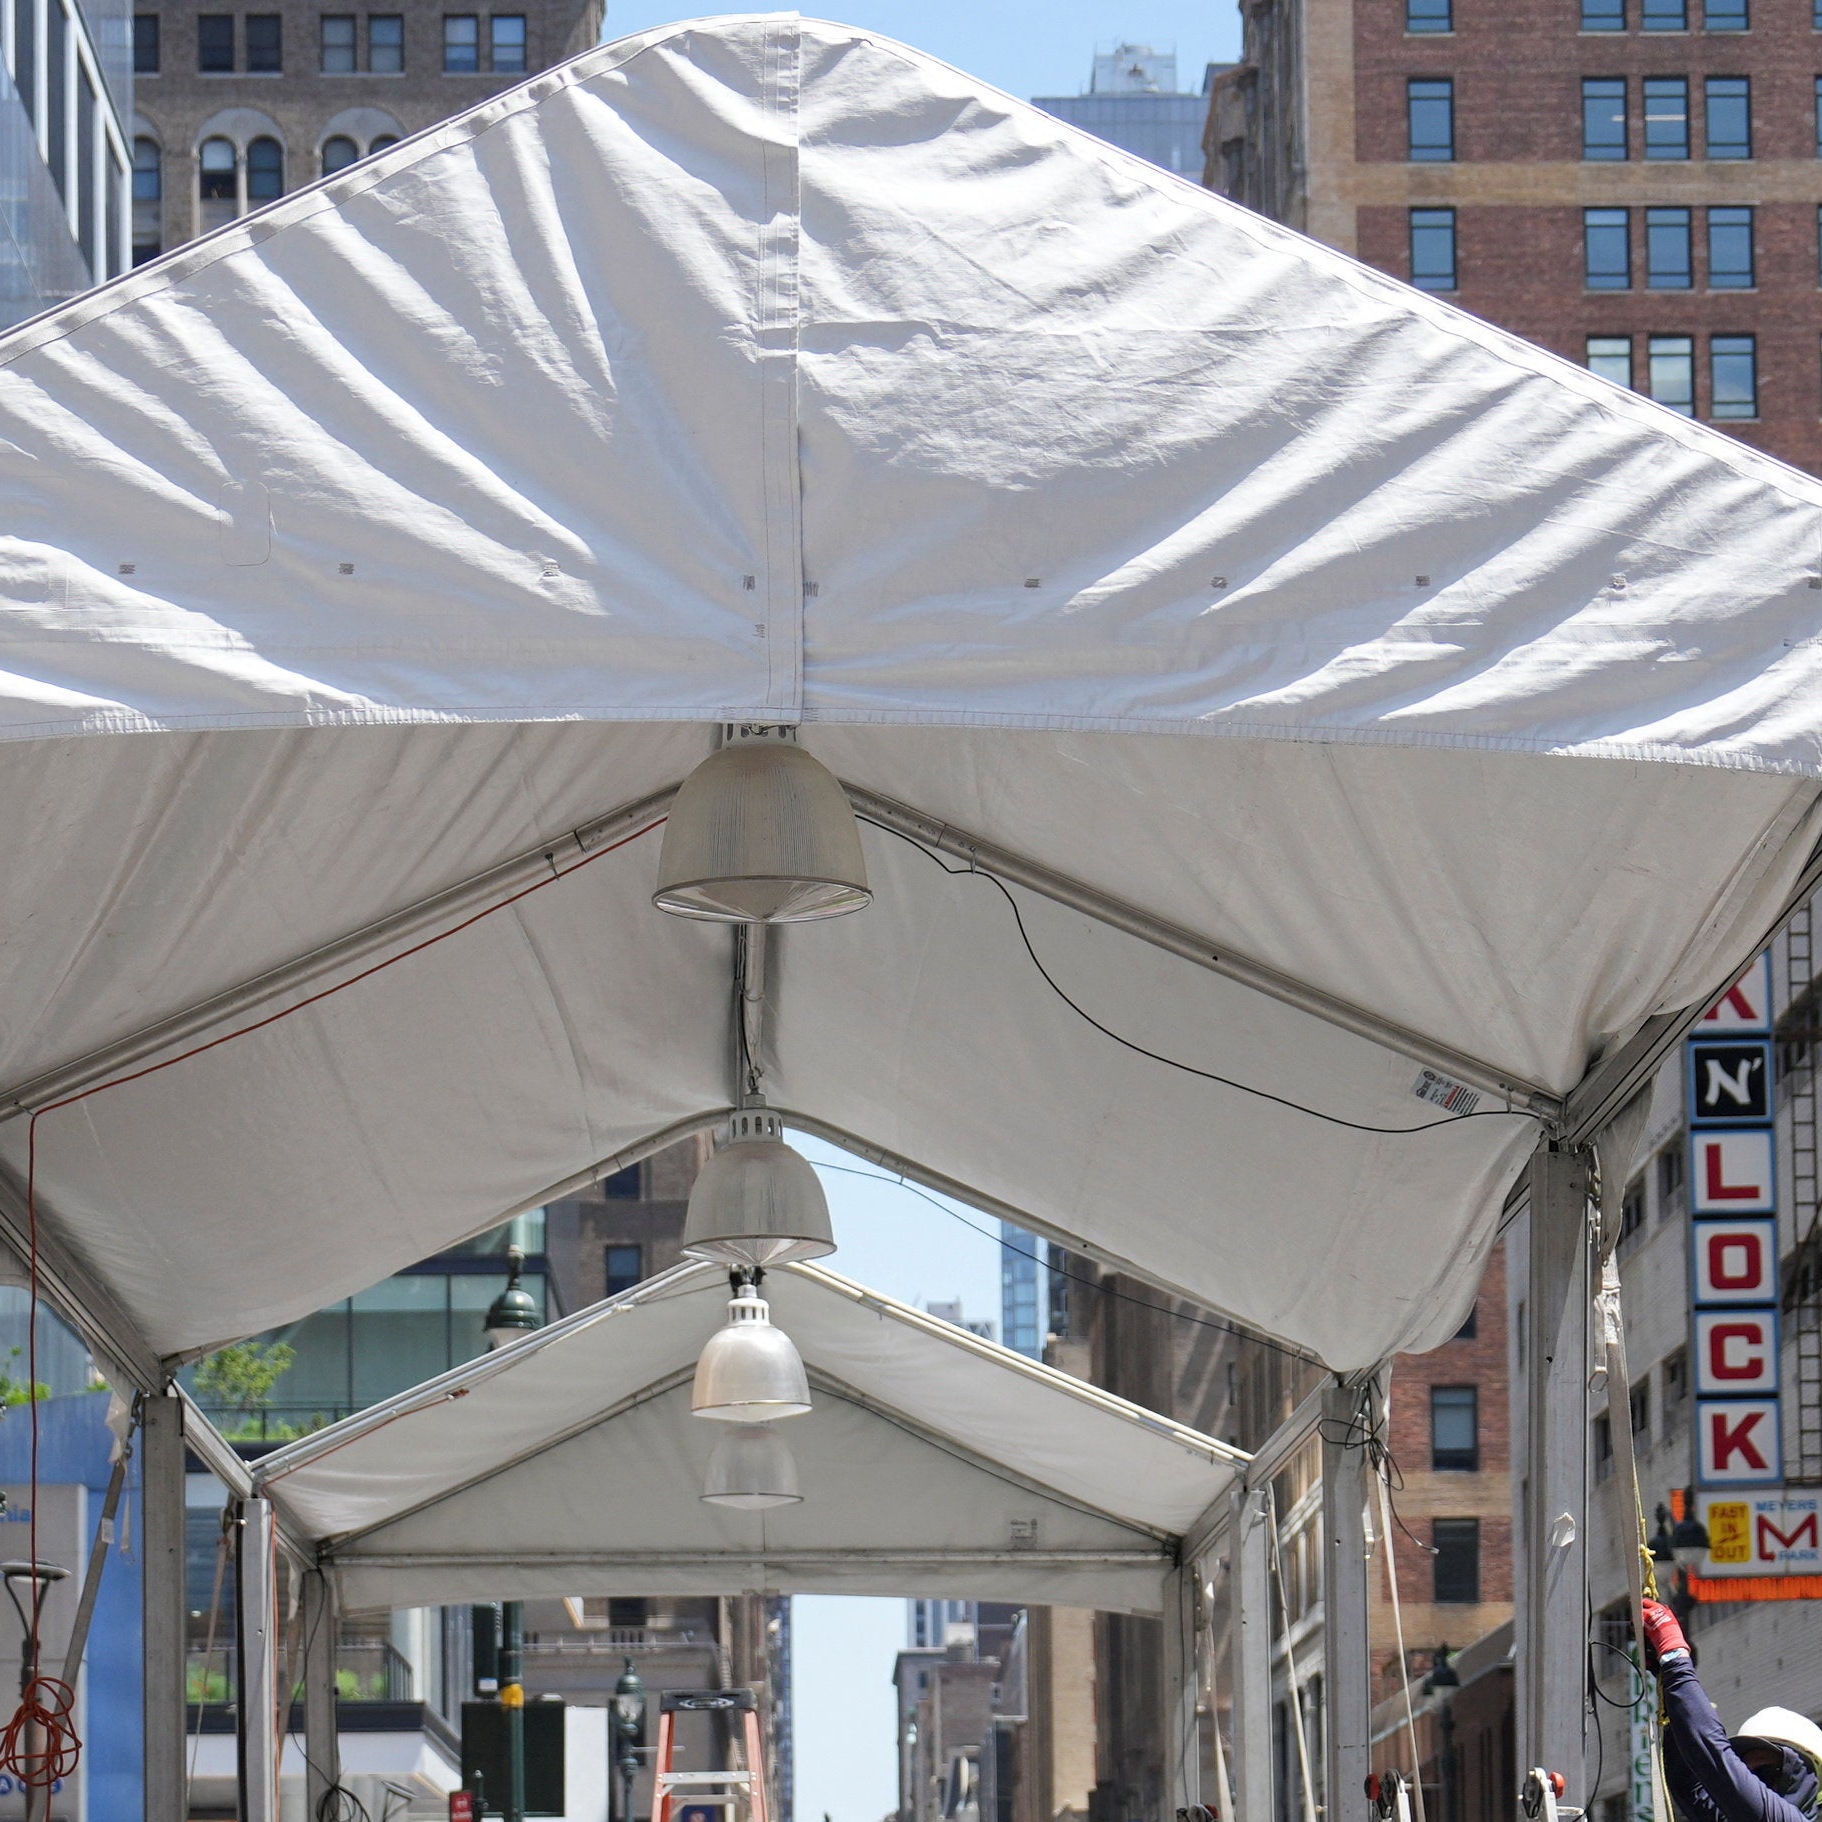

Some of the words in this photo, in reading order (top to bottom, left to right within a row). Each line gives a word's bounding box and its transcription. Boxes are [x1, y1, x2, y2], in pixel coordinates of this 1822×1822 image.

[1705, 1143, 1768, 1470] LOCK
[1711, 1505, 1747, 1518] FAST
[1722, 1523, 1737, 1534] IN
[1713, 1545, 1746, 1559] OUT
